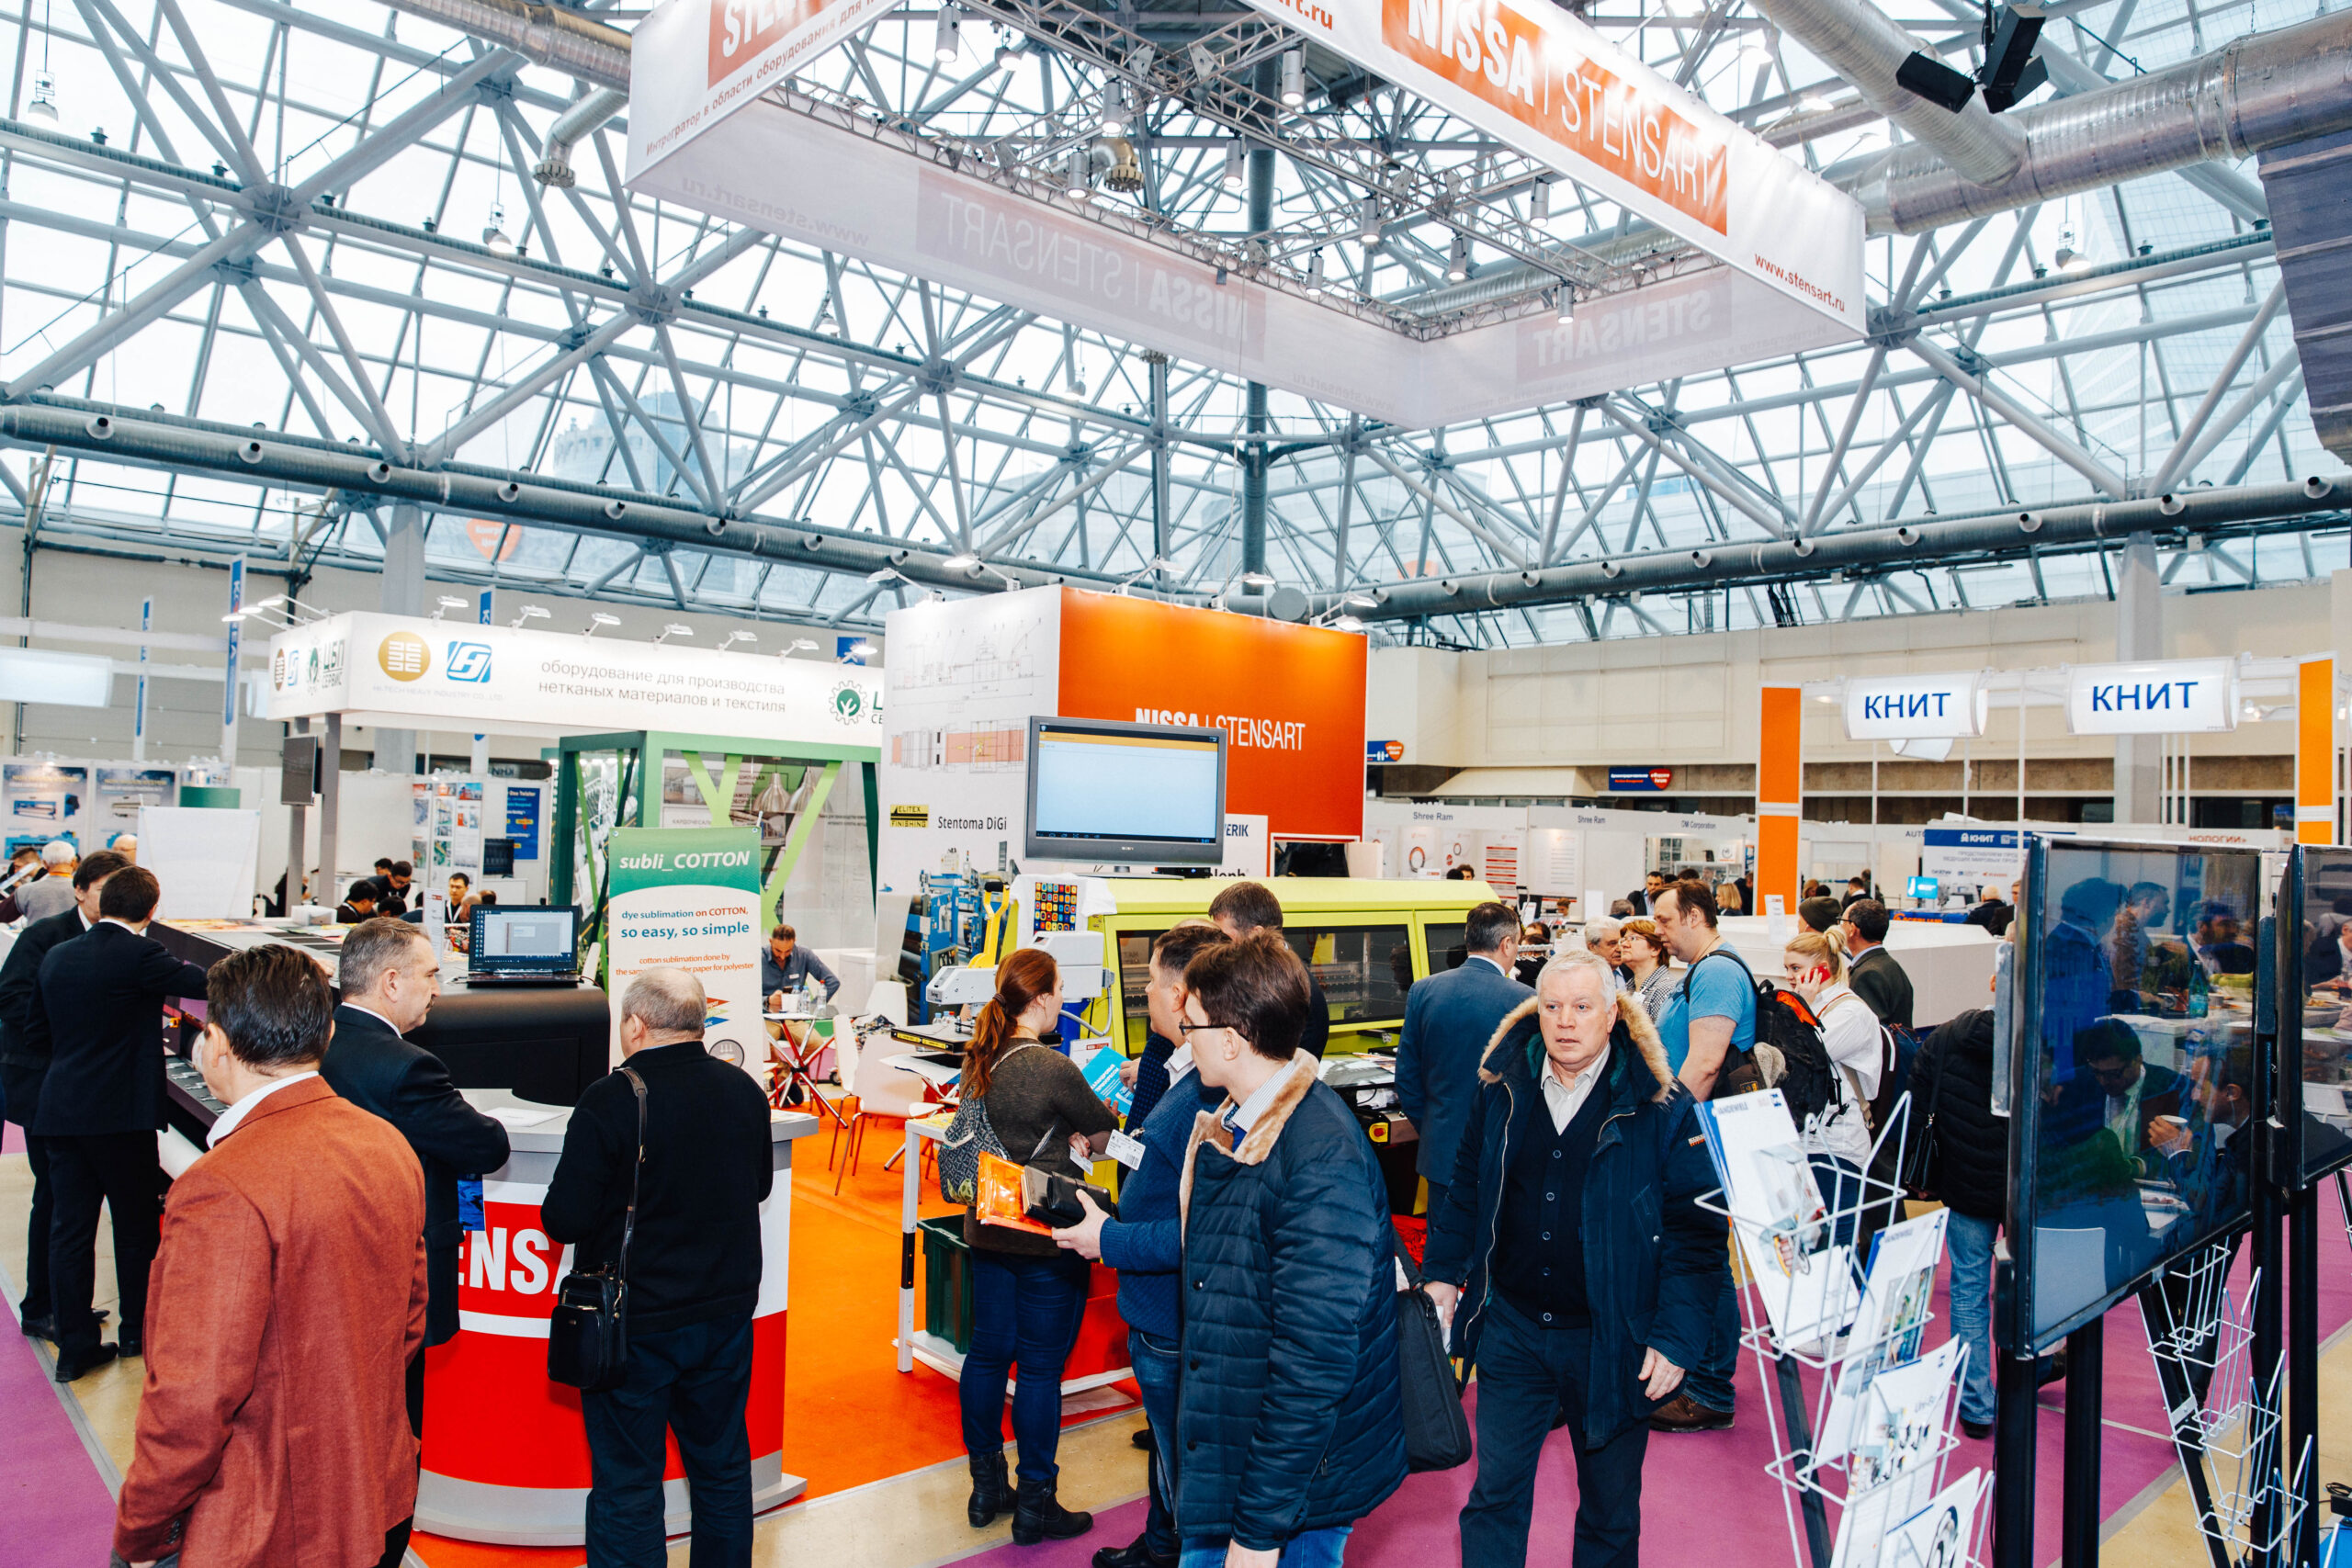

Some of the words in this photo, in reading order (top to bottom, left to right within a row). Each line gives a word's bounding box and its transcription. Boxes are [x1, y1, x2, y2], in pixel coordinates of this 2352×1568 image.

[712, 76, 752, 110] области
[757, 20, 835, 80] оборудования
[839, 3, 862, 26] для
[1408, 0, 1535, 108] NISSA
[1562, 68, 1713, 209] STENSART
[1754, 253, 1845, 313] www.stensart.ru
[541, 660, 653, 682] оборудование
[657, 672, 684, 686] для
[687, 675, 786, 696] производства
[538, 681, 614, 699] нетканых
[618, 689, 707, 708] материалов
[712, 697, 720, 707] и
[724, 697, 786, 714] текстиля
[1865, 693, 1951, 719] КНИТ
[2093, 682, 2199, 712] КНИТ
[938, 816, 984, 829] Stentoma
[987, 817, 1007, 830] DiGi
[1413, 811, 1434, 820] Shree
[1436, 812, 1453, 820] Ram
[1577, 815, 1593, 824] Shree
[1594, 816, 1606, 824] Ram
[1225, 823, 1249, 837] ERIK
[1969, 833, 1996, 843] КНИТ
[619, 851, 751, 872] subli_COTTON
[621, 911, 639, 920] dye
[640, 909, 694, 919] sublimation
[709, 907, 749, 917] COTTON,
[621, 928, 638, 938] so
[641, 926, 678, 940] easy,
[682, 927, 698, 936] so
[702, 921, 750, 936] simple
[662, 954, 702, 964] sublimation
[703, 953, 721, 962] done
[721, 953, 731, 963] by
[693, 965, 711, 974] paper
[723, 963, 754, 972] polyester
